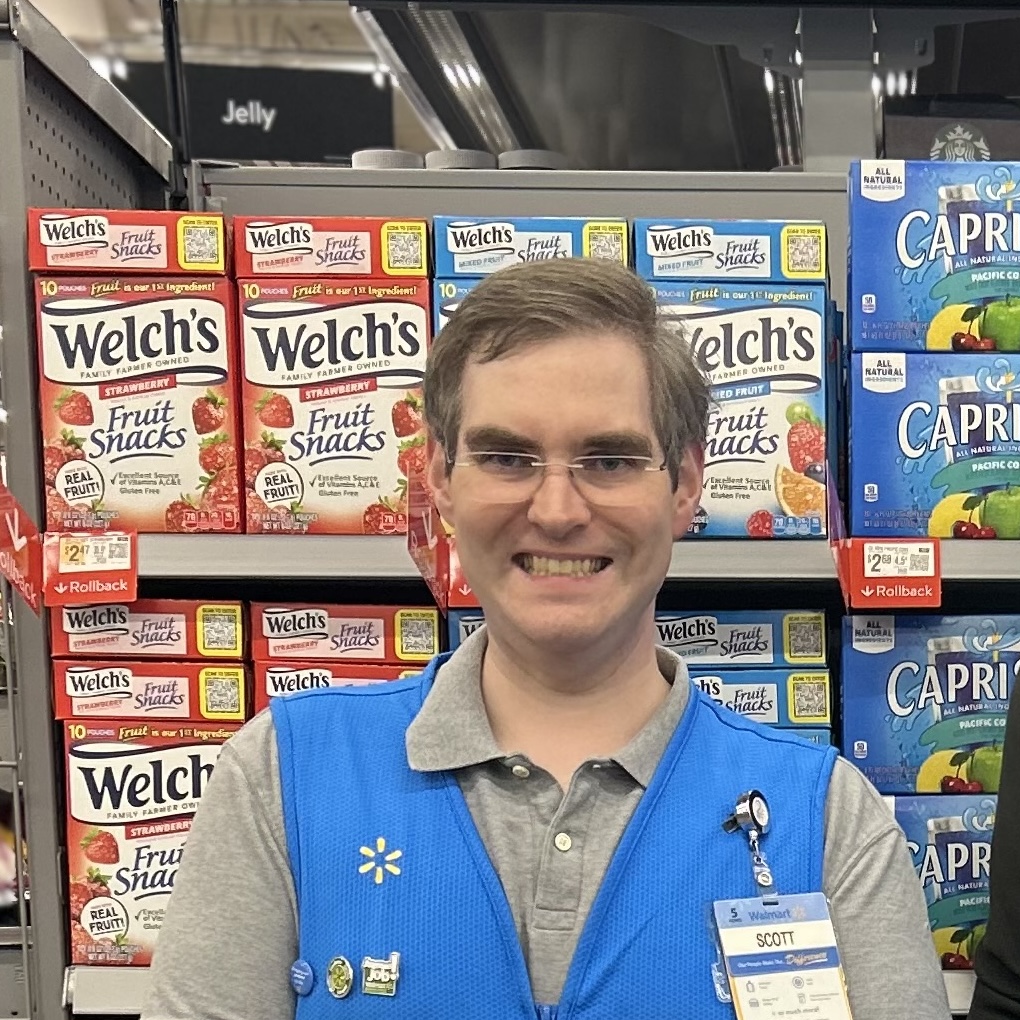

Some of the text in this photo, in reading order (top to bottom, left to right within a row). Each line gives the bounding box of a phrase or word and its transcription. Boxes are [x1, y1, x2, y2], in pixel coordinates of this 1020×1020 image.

[222, 101, 276, 131] Jelly
[43, 219, 106, 241] Welch's
[121, 229, 156, 247] Fruit
[249, 226, 311, 248] Welch's
[451, 225, 512, 248] Welch's
[325, 235, 360, 251] Fruit
[527, 235, 561, 251] Fruit
[650, 229, 711, 251] Welch's
[726, 238, 760, 255] Fruit
[110, 242, 162, 260] Snacks
[315, 248, 366, 266] Snacks
[715, 251, 766, 269] Snacks
[971, 272, 1005, 282] PACIFIC
[40, 280, 58, 296] 10
[90, 280, 121, 297] Fruit
[124, 283, 132, 292] is
[133, 284, 149, 292] our
[243, 283, 322, 299] 10 Fruit
[439, 283, 456, 298] 10
[689, 286, 720, 302] Fruit
[49, 308, 220, 369] Welch's
[251, 312, 420, 371] Welch's
[691, 316, 815, 373] elch's
[80, 356, 190, 380] FAMILY FARMER OWNED
[712, 364, 785, 381] FARMER OWNED
[104, 377, 170, 397] STRAWBERRY
[305, 380, 371, 400] STRAWBERRY
[735, 385, 765, 397] FRUIT
[108, 400, 174, 433] Fruit
[307, 402, 374, 435] Fruit
[705, 406, 769, 443] Fruit
[89, 424, 187, 459] Snacks
[288, 428, 387, 461] Snacks
[704, 431, 779, 459] nacks
[970, 446, 1007, 455] NATURAL
[972, 462, 1006, 472] PACIFIC
[65, 470, 93, 485] REAL
[118, 472, 179, 480] Excellent Source
[264, 473, 294, 488] REAL
[63, 484, 100, 498] FRUIT!
[263, 485, 299, 500] FRUIT!
[0, 551, 37, 608] ollback
[70, 579, 128, 593] Rollback
[876, 585, 932, 597] Rollback
[66, 608, 127, 629] Welch's
[141, 618, 176, 633] Fruit
[266, 612, 326, 633] Welch's
[340, 621, 375, 638] Fruit
[657, 619, 716, 642] Welch's
[730, 627, 763, 643] Fruit
[130, 630, 181, 647] Snacks
[330, 634, 380, 651] Snacks
[720, 640, 769, 657] Snacks
[69, 671, 130, 692] Welch's
[144, 680, 179, 697] Fruit
[269, 671, 330, 692] Welch's
[134, 693, 185, 711] Snacks
[735, 687, 767, 702] Fruit
[725, 700, 773, 714] Snacks
[68, 724, 149, 740] 10 Fruit
[77, 754, 214, 810] Welch
[90, 907, 118, 921] REAL
[731, 908, 791, 921] 5 Walmart
[89, 918, 125, 932] FRUIT!
[756, 931, 794, 948] SCOTT
